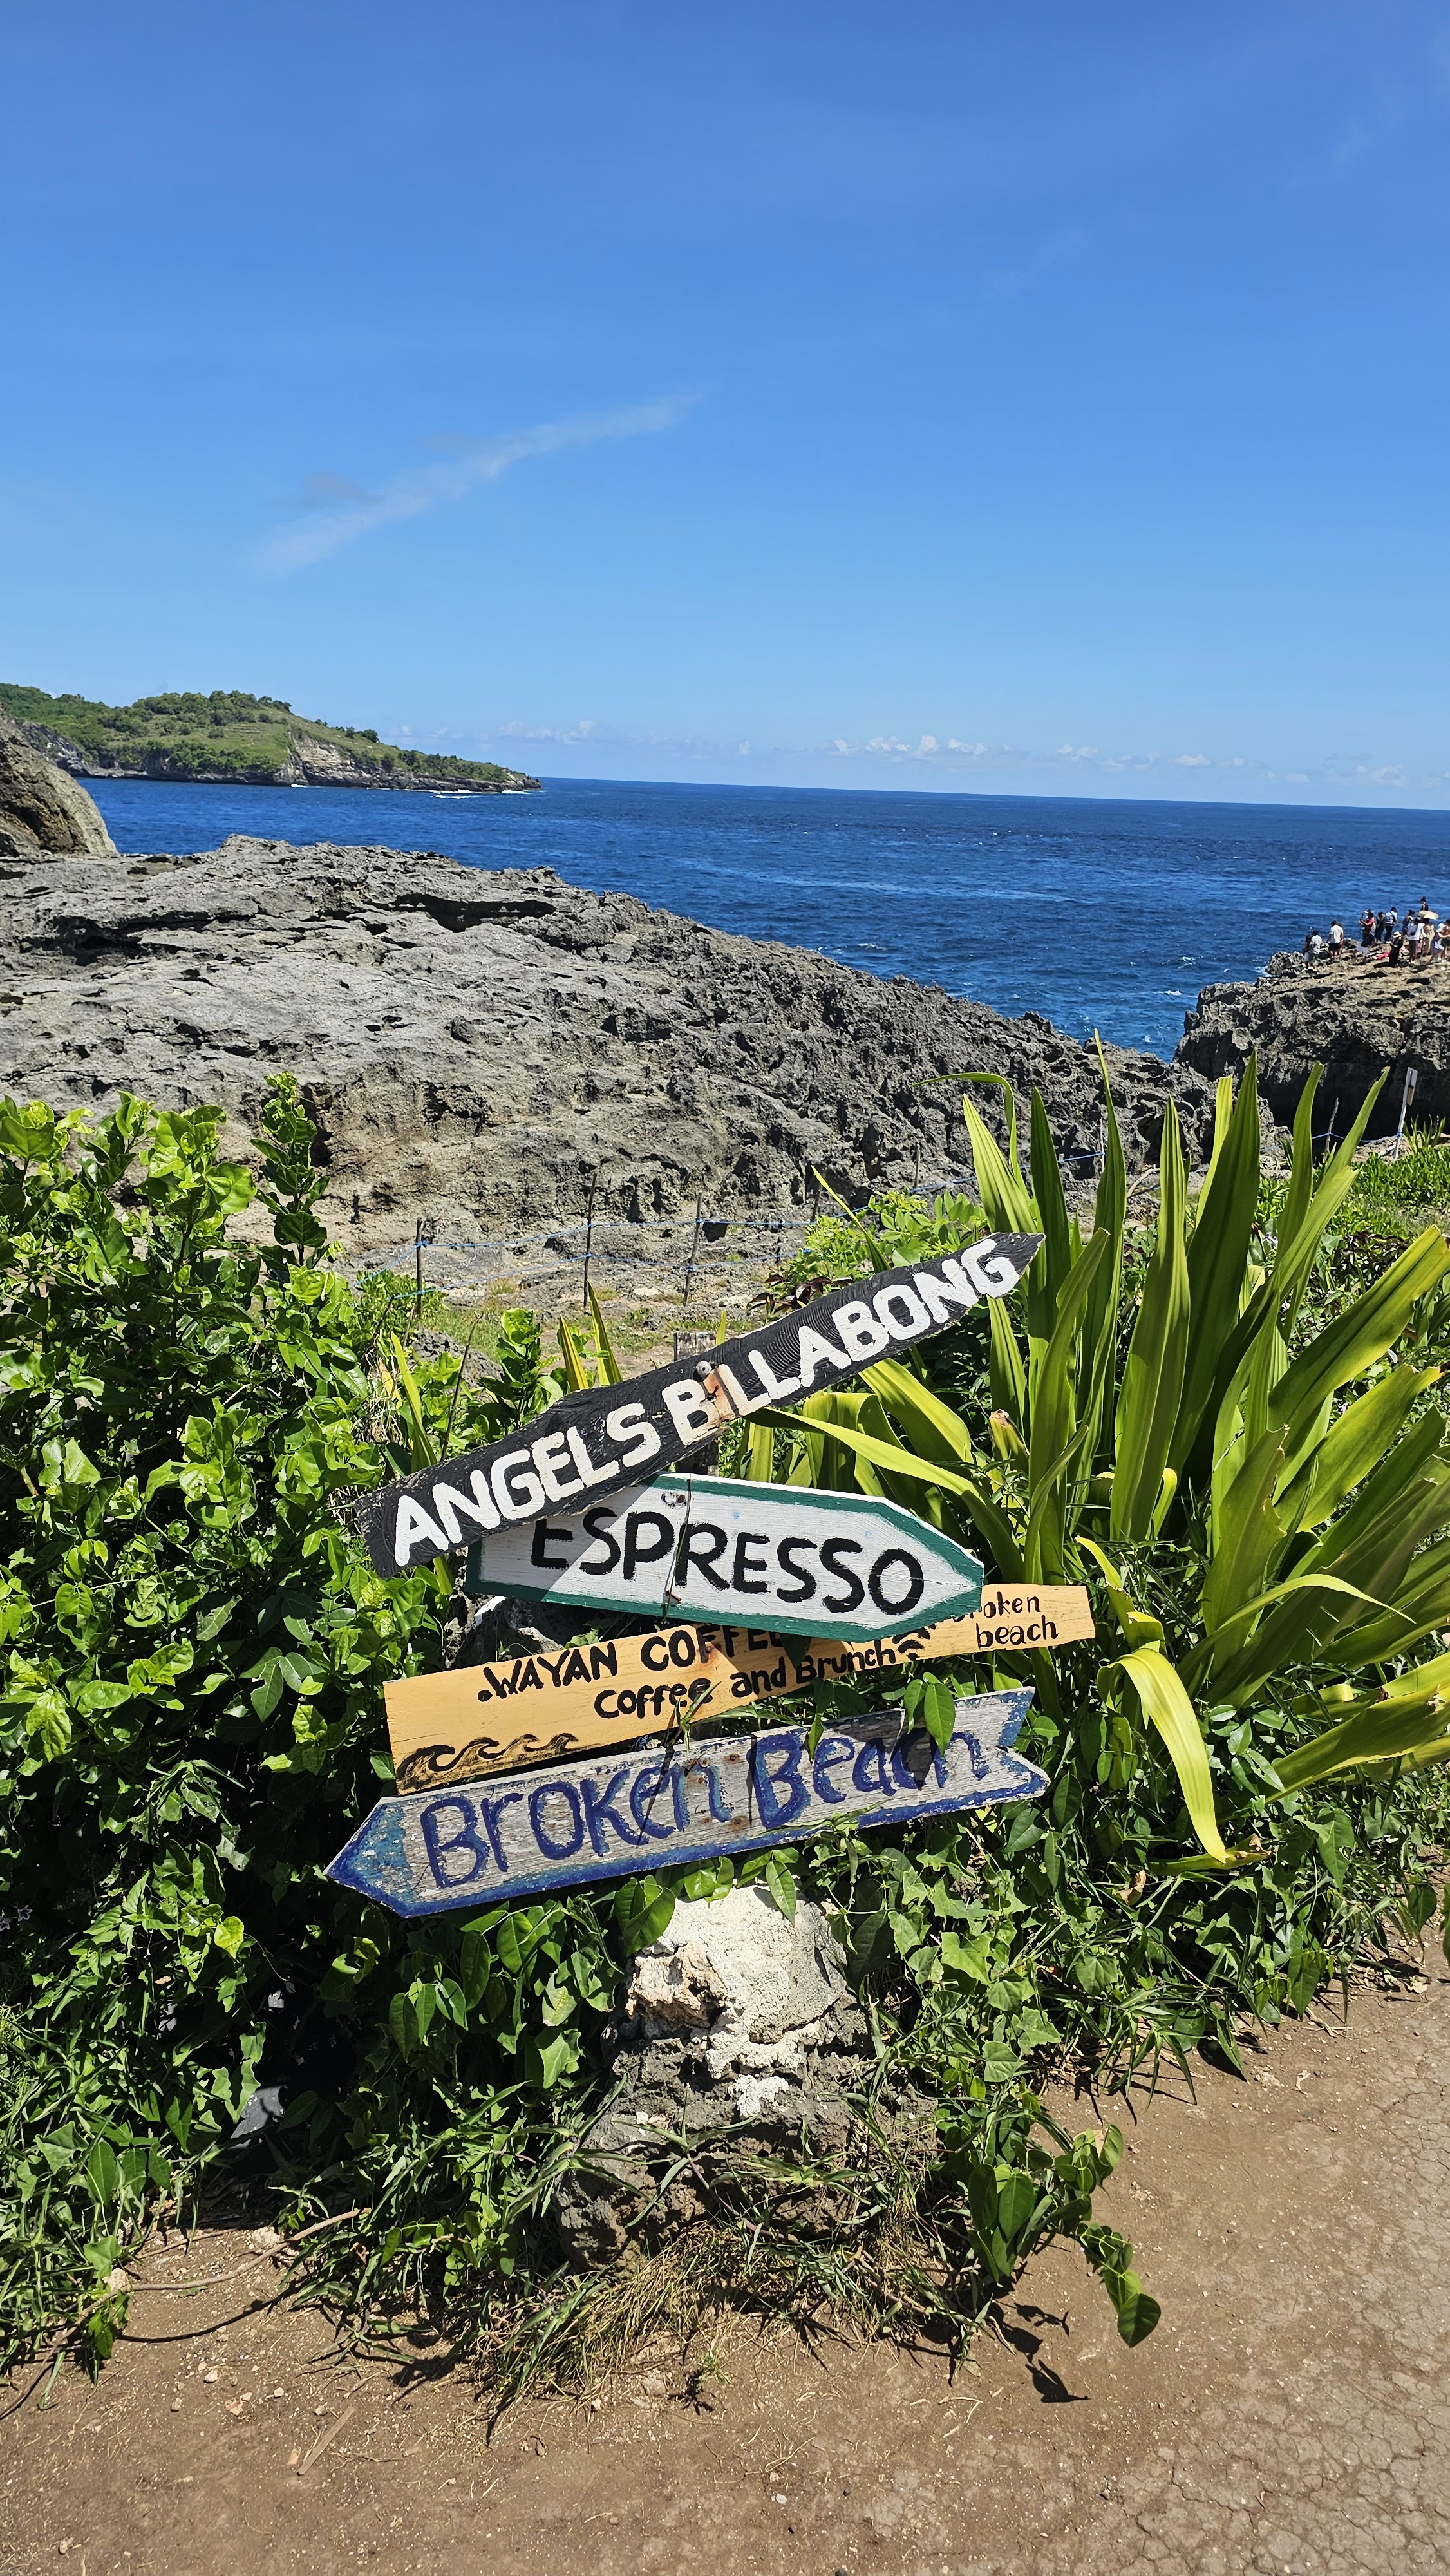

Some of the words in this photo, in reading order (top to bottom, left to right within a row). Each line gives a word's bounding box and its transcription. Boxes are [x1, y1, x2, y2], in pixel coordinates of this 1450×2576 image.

[394, 1401, 662, 1567] ANGELS
[661, 1237, 1020, 1446] BILLABONG
[531, 1506, 925, 1615] ESPRESSO
[975, 1614, 1059, 1649] beach
[729, 1656, 786, 1698] and
